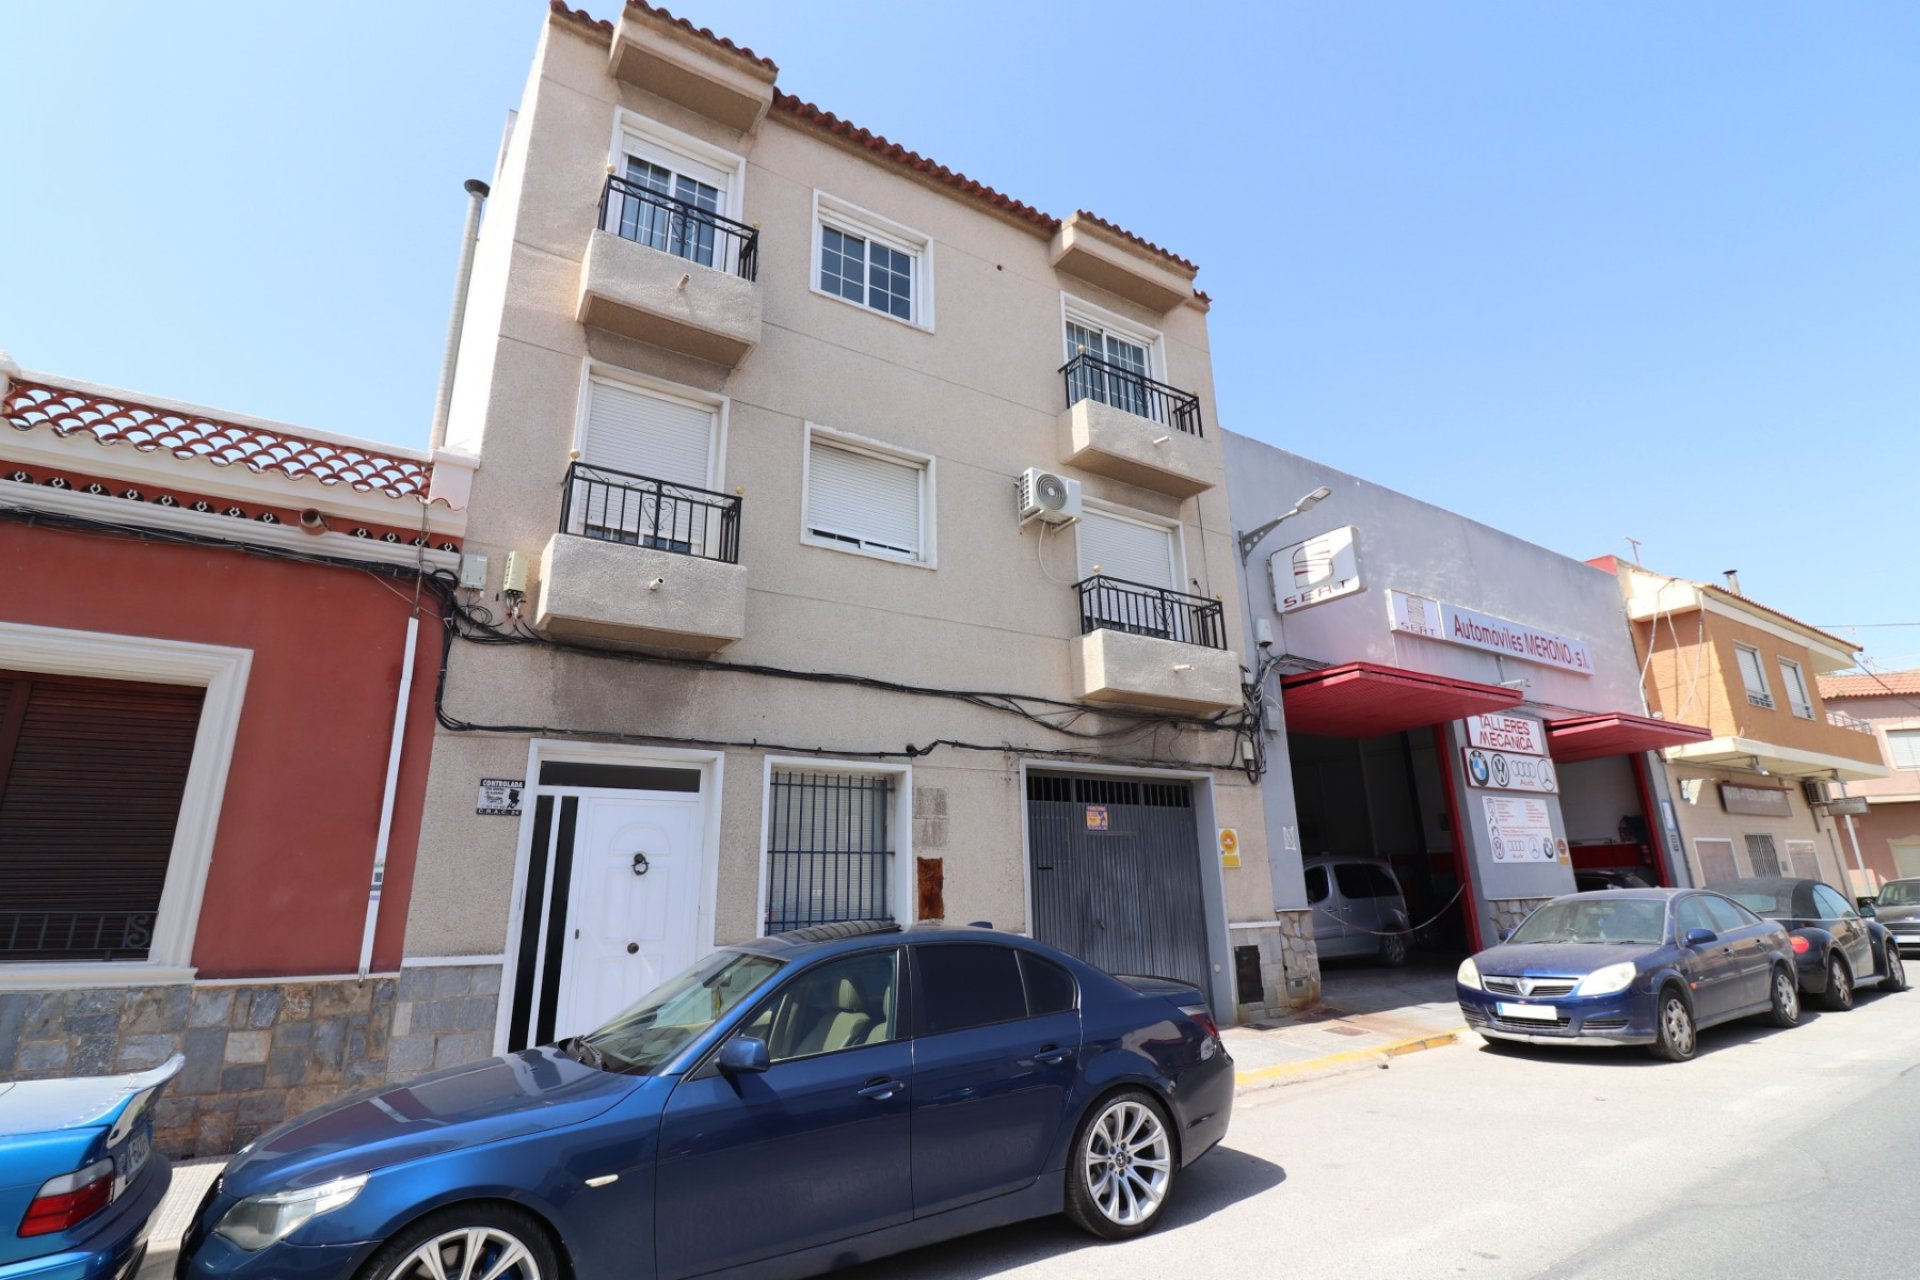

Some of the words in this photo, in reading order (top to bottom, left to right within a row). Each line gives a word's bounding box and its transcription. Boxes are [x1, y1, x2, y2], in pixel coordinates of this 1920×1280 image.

[1284, 578, 1350, 608] SEAT
[1401, 622, 1435, 636] SEAT
[1454, 614, 1524, 653] Automóviles
[1480, 714, 1530, 736] TALLERES
[1480, 731, 1535, 752] MECANICA
